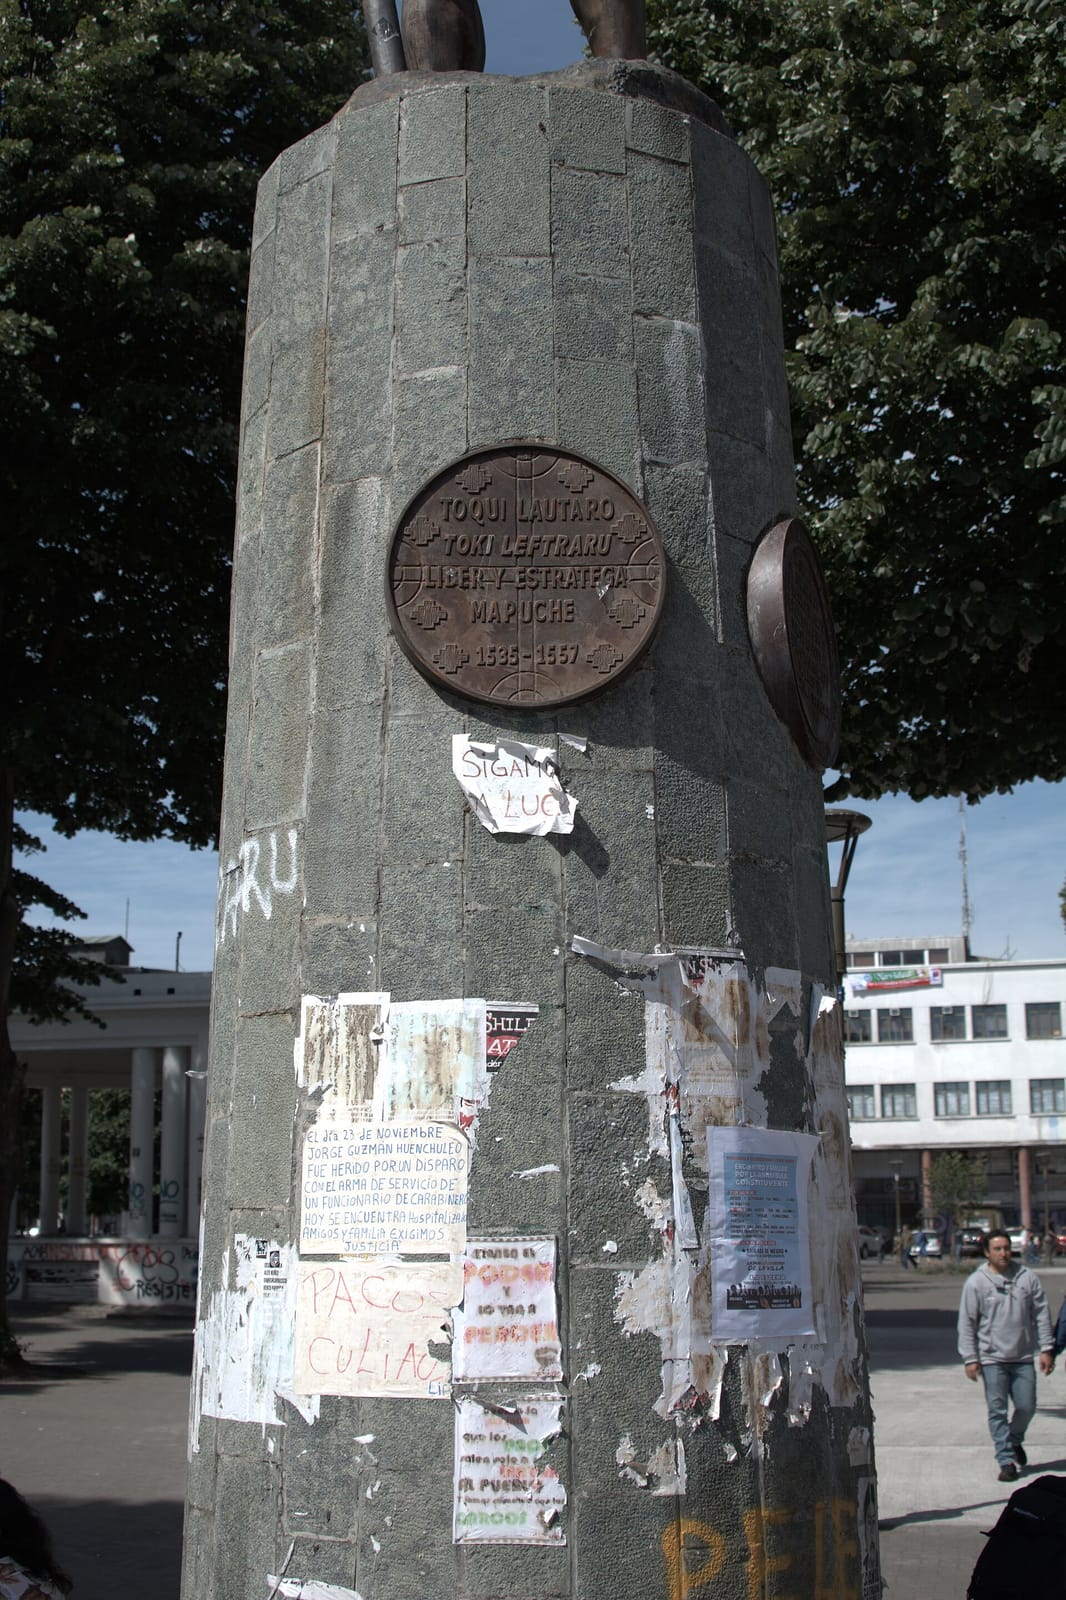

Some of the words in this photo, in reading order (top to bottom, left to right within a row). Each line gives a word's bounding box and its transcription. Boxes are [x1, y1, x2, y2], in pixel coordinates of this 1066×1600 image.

[440, 498, 507, 527] TOQUI
[518, 498, 615, 523] LAUTARO
[443, 534, 495, 557] TOKI
[500, 533, 613, 558] LEFTRARU
[493, 567, 505, 590] Y
[516, 567, 628, 591] ESTRATEGA
[471, 599, 575, 624] MAPUCHE
[343, 1129, 355, 1140] 23
[308, 1146, 343, 1160] JORGE
[308, 1163, 327, 1178] FUE
[374, 1160, 396, 1172] POR
[399, 1160, 411, 1172] UN
[339, 1179, 367, 1191] ARMA
[371, 1178, 386, 1191] DE
[440, 1178, 458, 1191] DE
[305, 1196, 318, 1209] UN
[396, 1193, 408, 1205] DE
[305, 1213, 324, 1226] HOY
[329, 1212, 340, 1225] SE
[344, 1210, 406, 1224] ENCUENTRA
